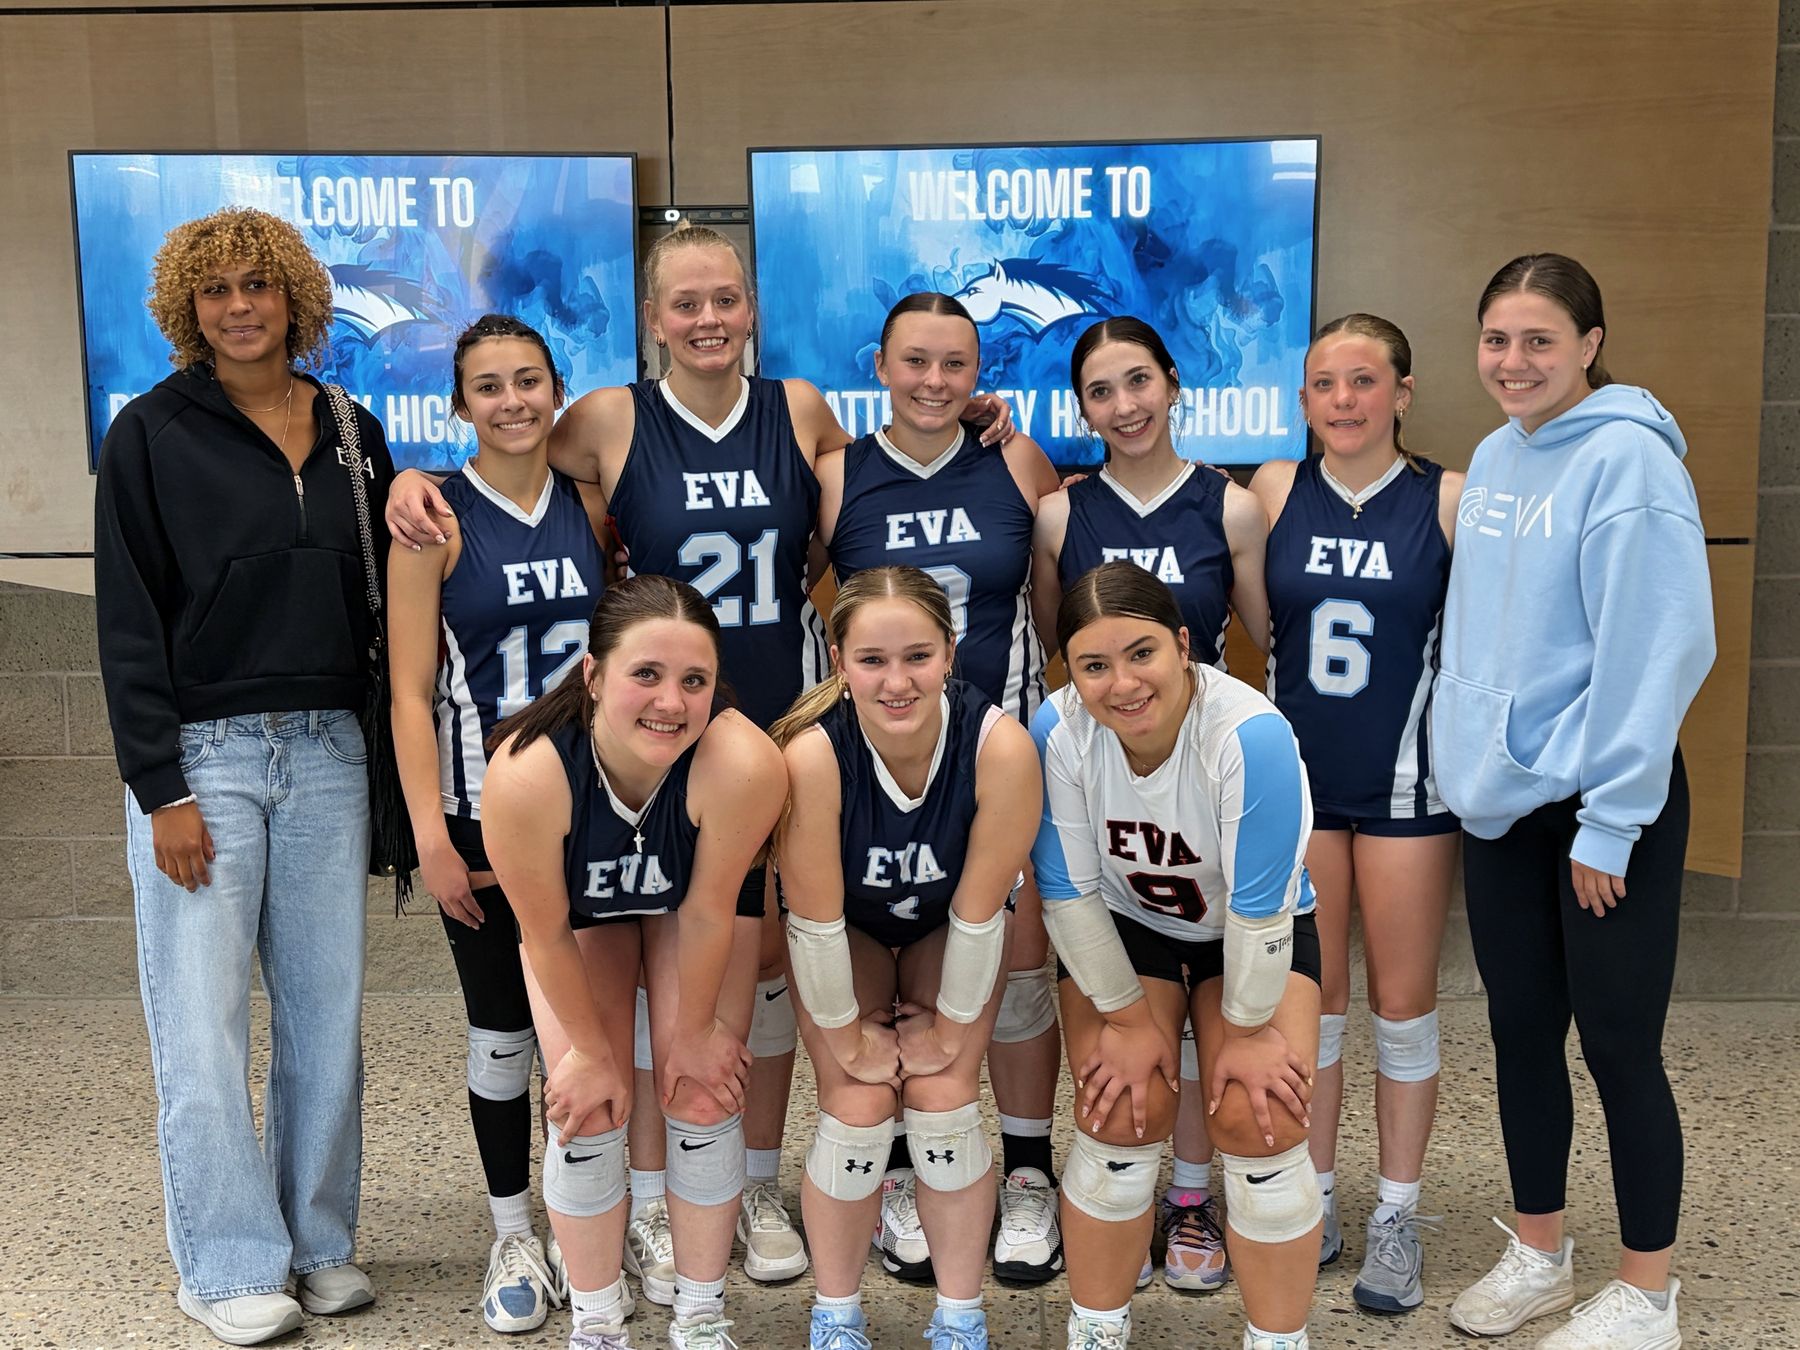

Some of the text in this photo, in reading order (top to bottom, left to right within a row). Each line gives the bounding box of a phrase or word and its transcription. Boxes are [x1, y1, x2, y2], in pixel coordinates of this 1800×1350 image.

[236, 176, 474, 227] ELCOME TO
[908, 165, 1151, 221] WELCOME TO
[1178, 386, 1288, 437] CHOOL
[336, 446, 375, 479] EA
[682, 469, 771, 511] EVA
[885, 507, 982, 550] EVA
[502, 556, 589, 606] EVA
[677, 528, 781, 628] 21
[1304, 535, 1393, 581] EVA
[496, 619, 590, 720] 12
[1307, 597, 1376, 699] 6
[862, 841, 948, 888] EVA
[1106, 819, 1202, 868] EVA
[583, 852, 674, 898] EVA
[1126, 871, 1208, 924] 9
